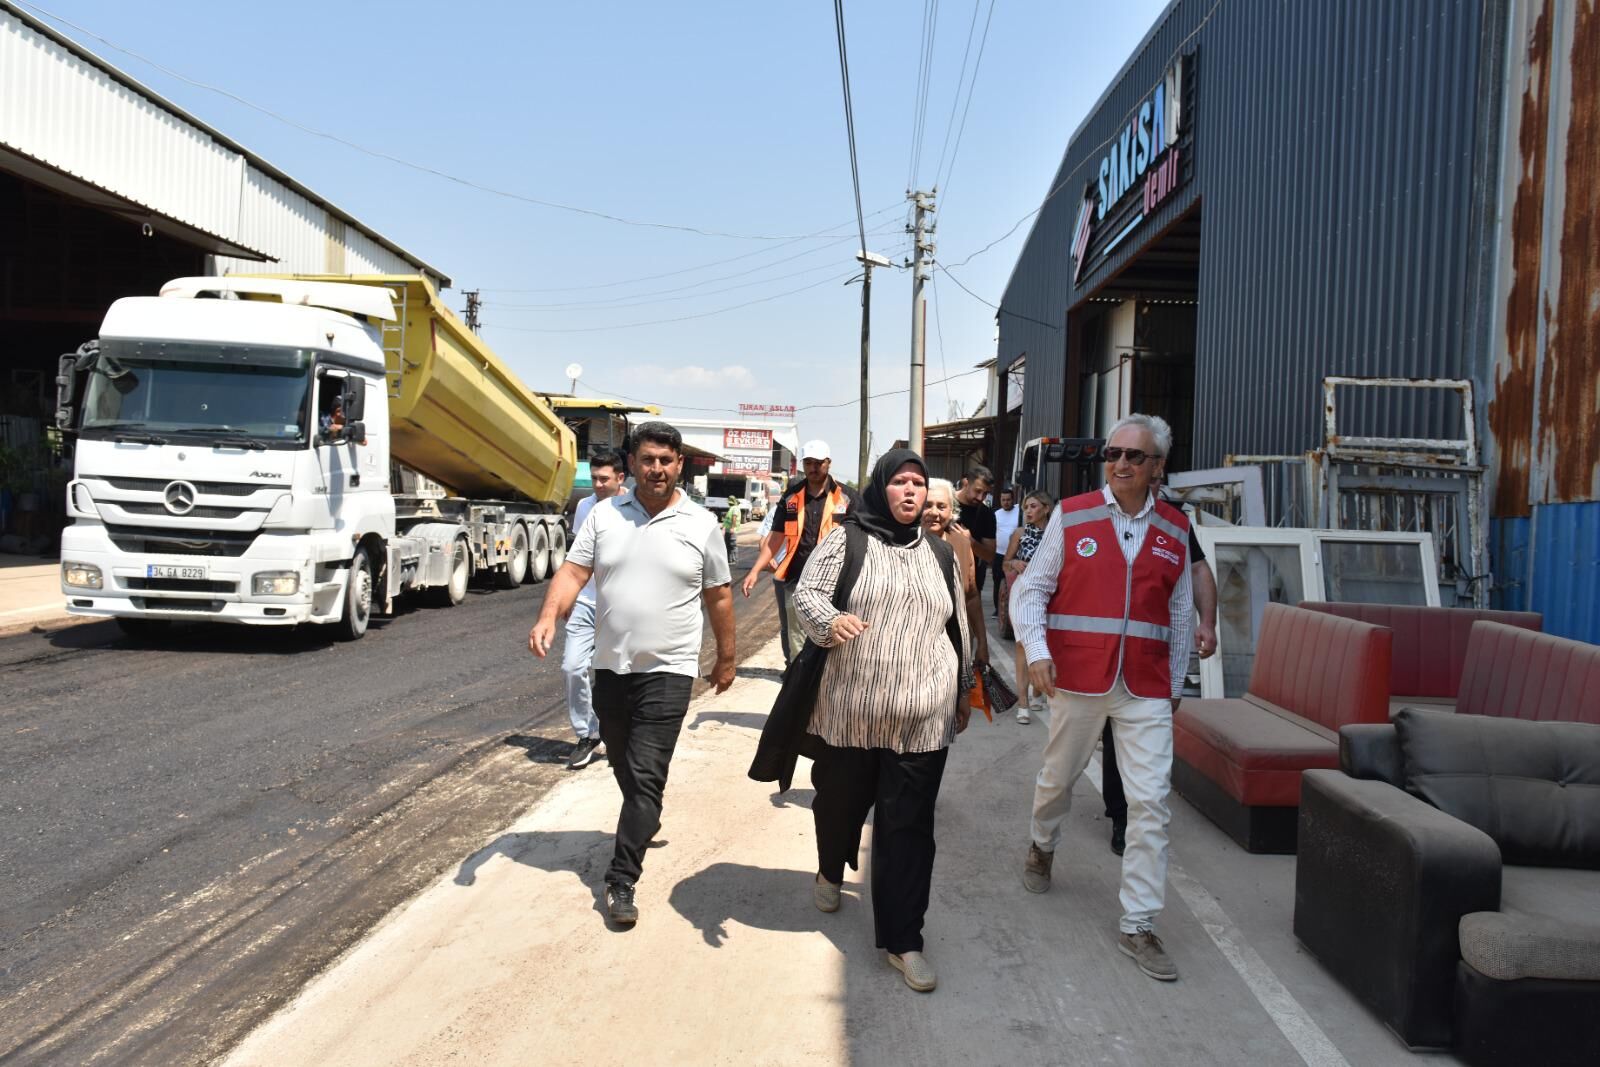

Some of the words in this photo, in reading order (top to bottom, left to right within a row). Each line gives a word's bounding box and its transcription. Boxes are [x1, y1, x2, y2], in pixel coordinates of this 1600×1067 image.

[153, 567, 163, 577] 34
[167, 567, 177, 577] GA
[182, 568, 203, 578] 8229
